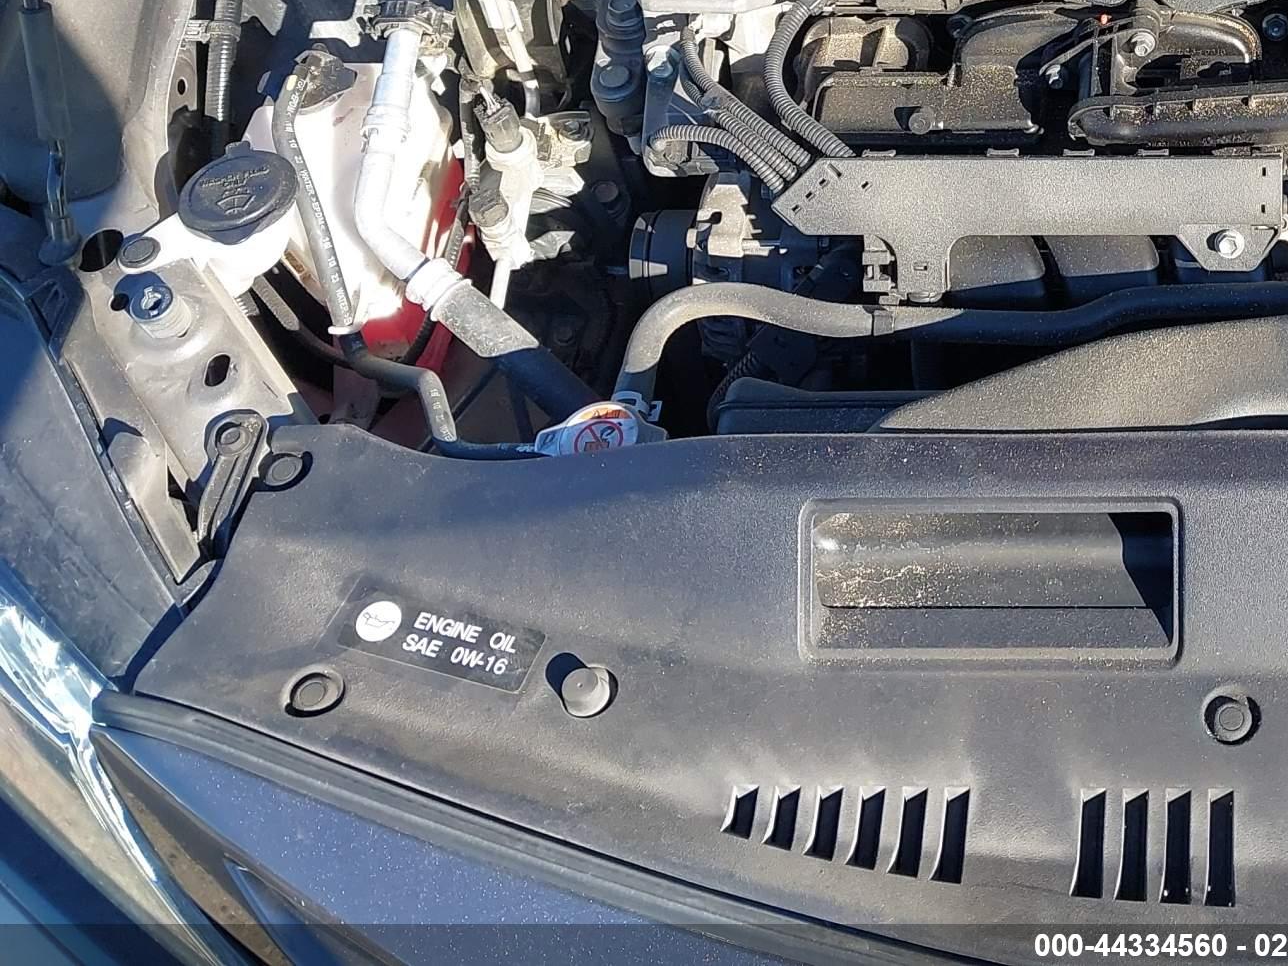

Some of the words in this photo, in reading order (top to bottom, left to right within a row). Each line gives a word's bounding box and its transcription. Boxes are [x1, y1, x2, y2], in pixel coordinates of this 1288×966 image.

[300, 168, 316, 196] WATER
[335, 286, 350, 314] WATER
[413, 611, 483, 643] ENGINE
[489, 632, 518, 654] OIL
[402, 634, 443, 658] SAE
[450, 646, 509, 675] 0W-16
